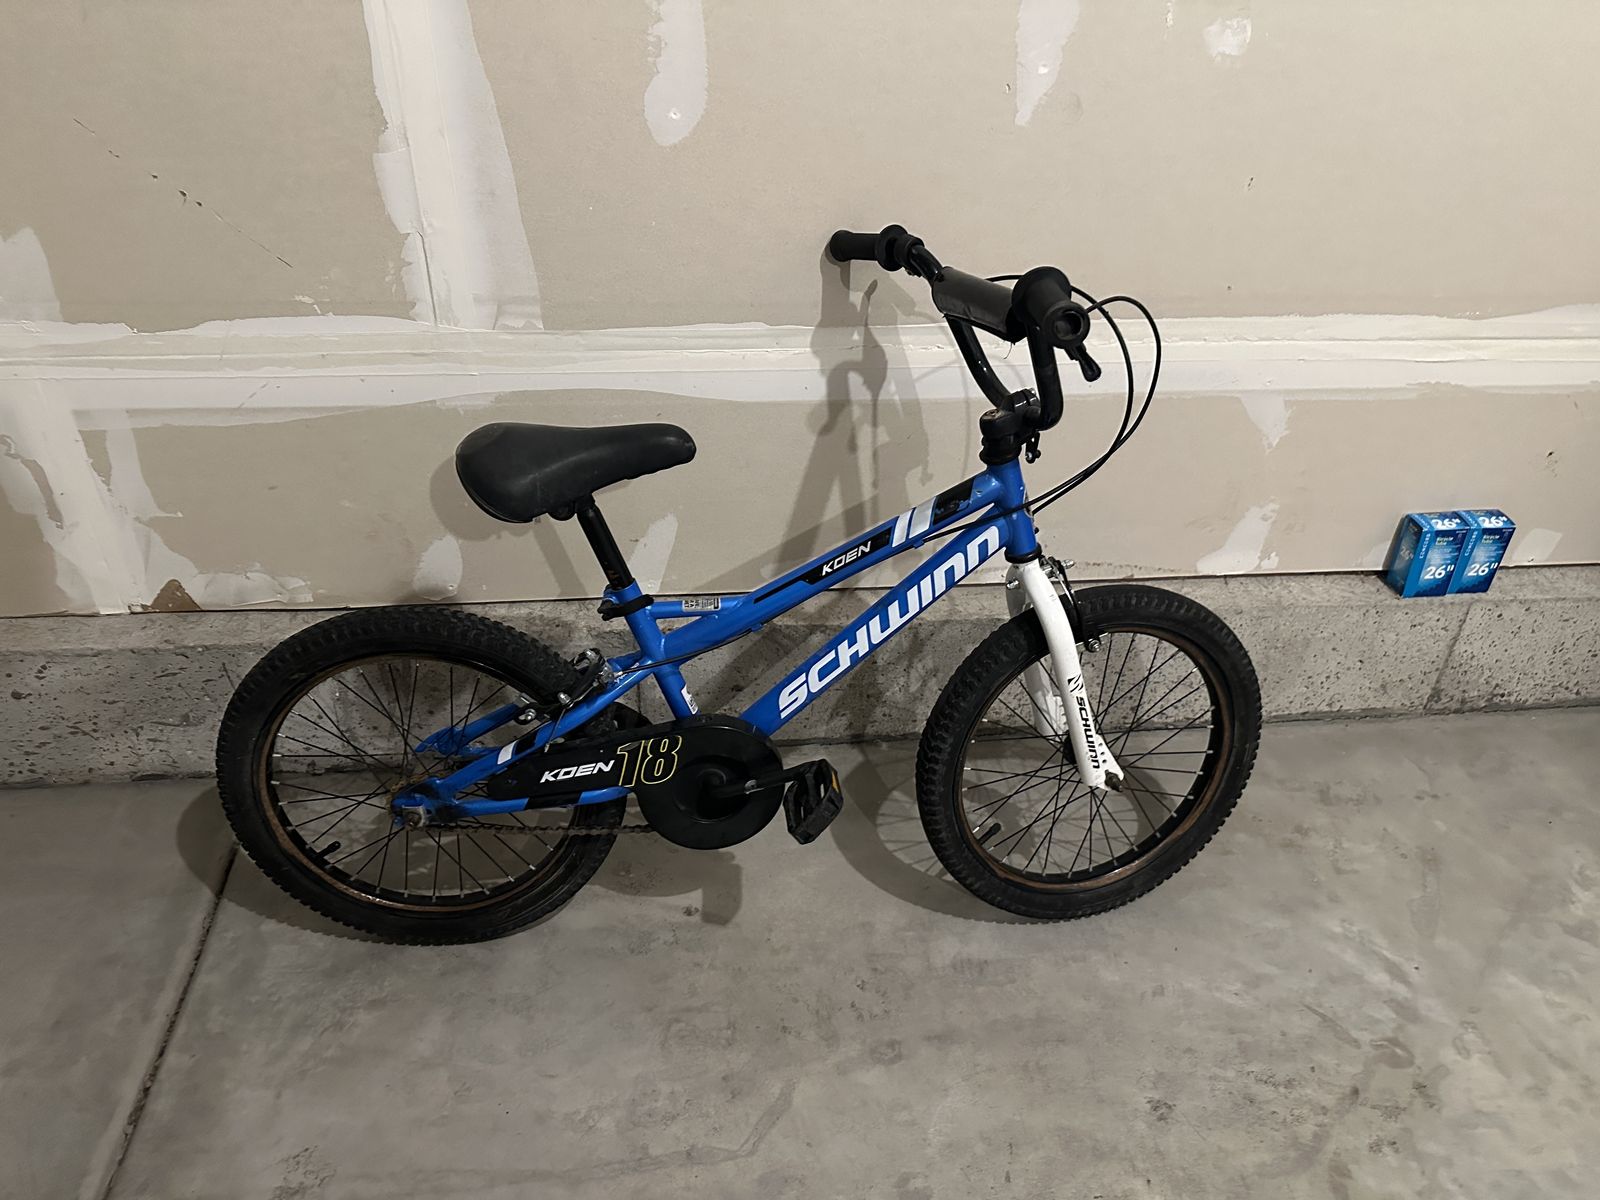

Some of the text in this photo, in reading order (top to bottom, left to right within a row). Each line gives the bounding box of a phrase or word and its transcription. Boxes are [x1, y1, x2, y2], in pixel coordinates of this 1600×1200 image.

[1431, 518, 1461, 530] 26"
[1479, 516, 1508, 528] 26"
[821, 541, 871, 576] KOEN
[1467, 562, 1499, 577] 26"
[1423, 564, 1455, 580] 26"
[778, 525, 1000, 719] SCHWINN
[1076, 696, 1101, 769] SCHWINN
[539, 735, 683, 787] KOEN 18
